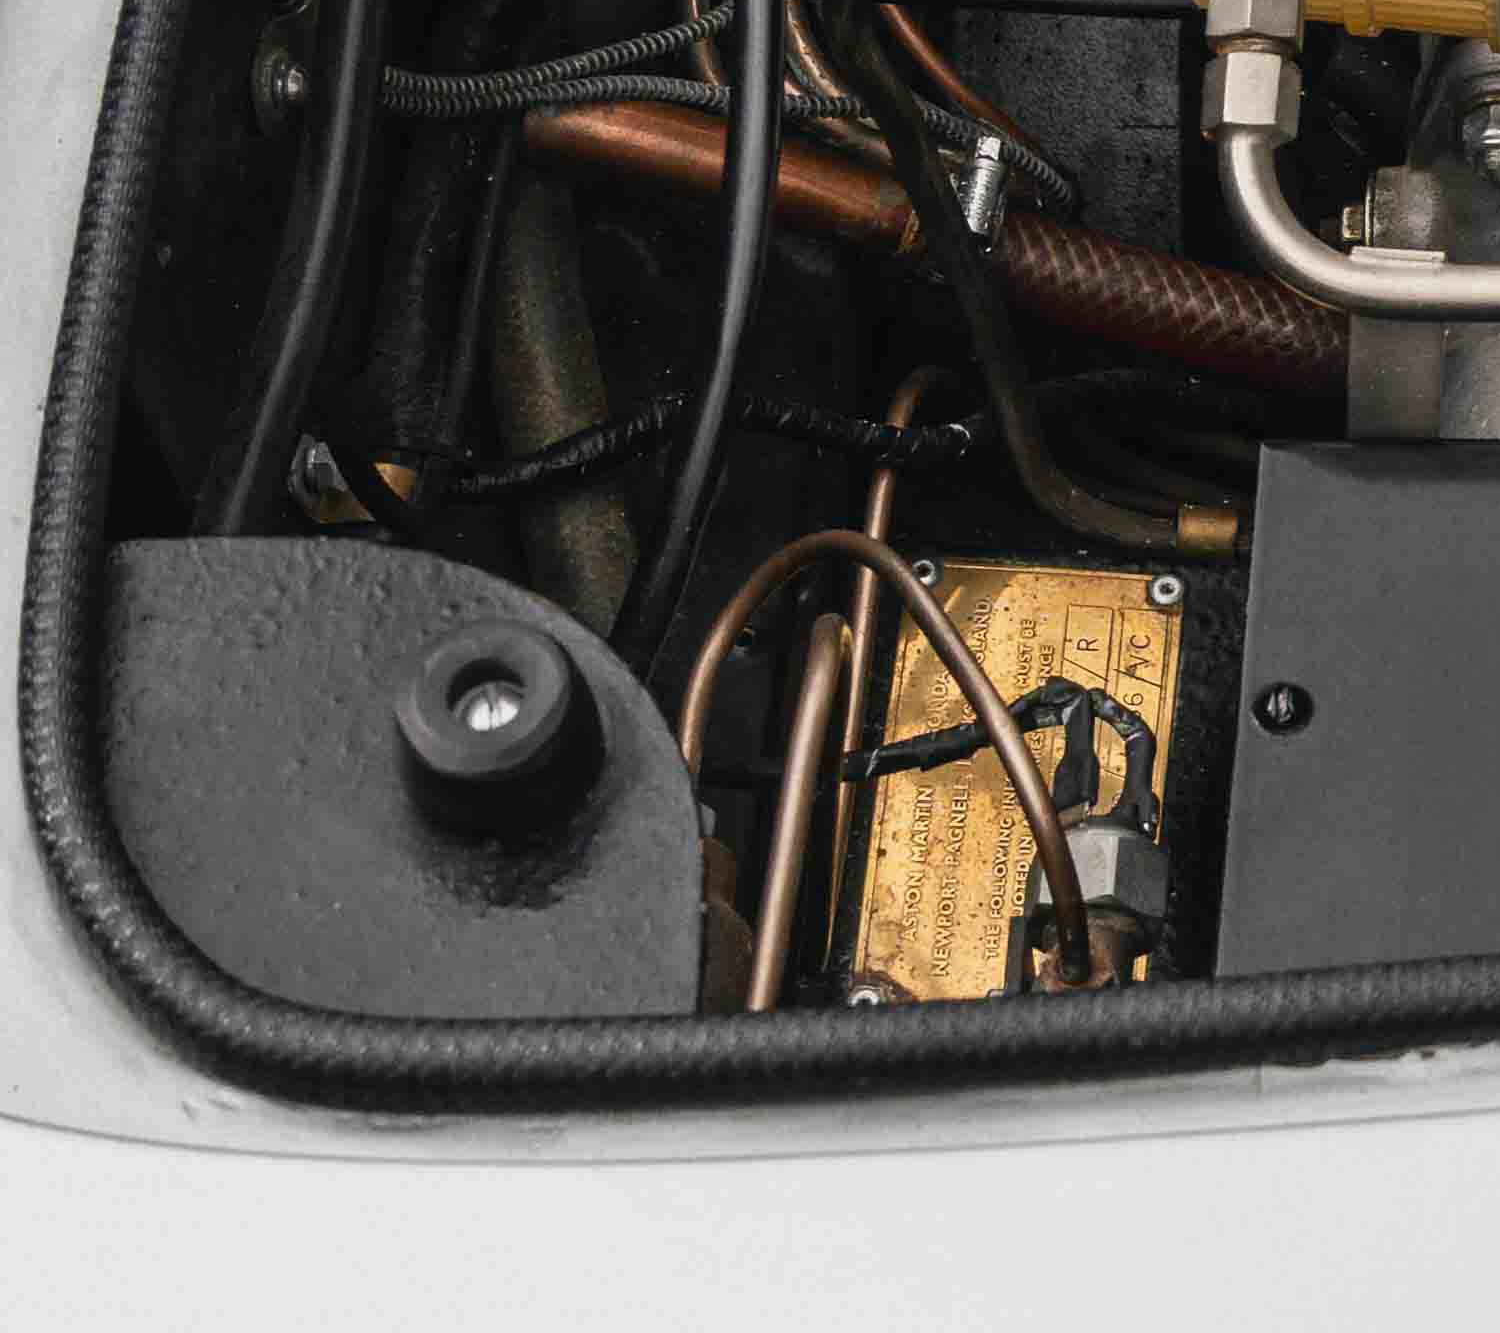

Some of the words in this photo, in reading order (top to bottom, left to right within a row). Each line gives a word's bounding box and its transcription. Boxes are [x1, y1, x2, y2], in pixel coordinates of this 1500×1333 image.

[1021, 618, 1036, 638] BE
[1076, 637, 1101, 652] R
[1015, 645, 1033, 688] MUST
[911, 786, 935, 863] MARTIN
[1018, 835, 1033, 855] IN
[990, 815, 1014, 919] FOLLOWING
[902, 870, 923, 942] ASTON
[931, 876, 959, 978] NEWPORT
[984, 923, 1001, 961] THE
